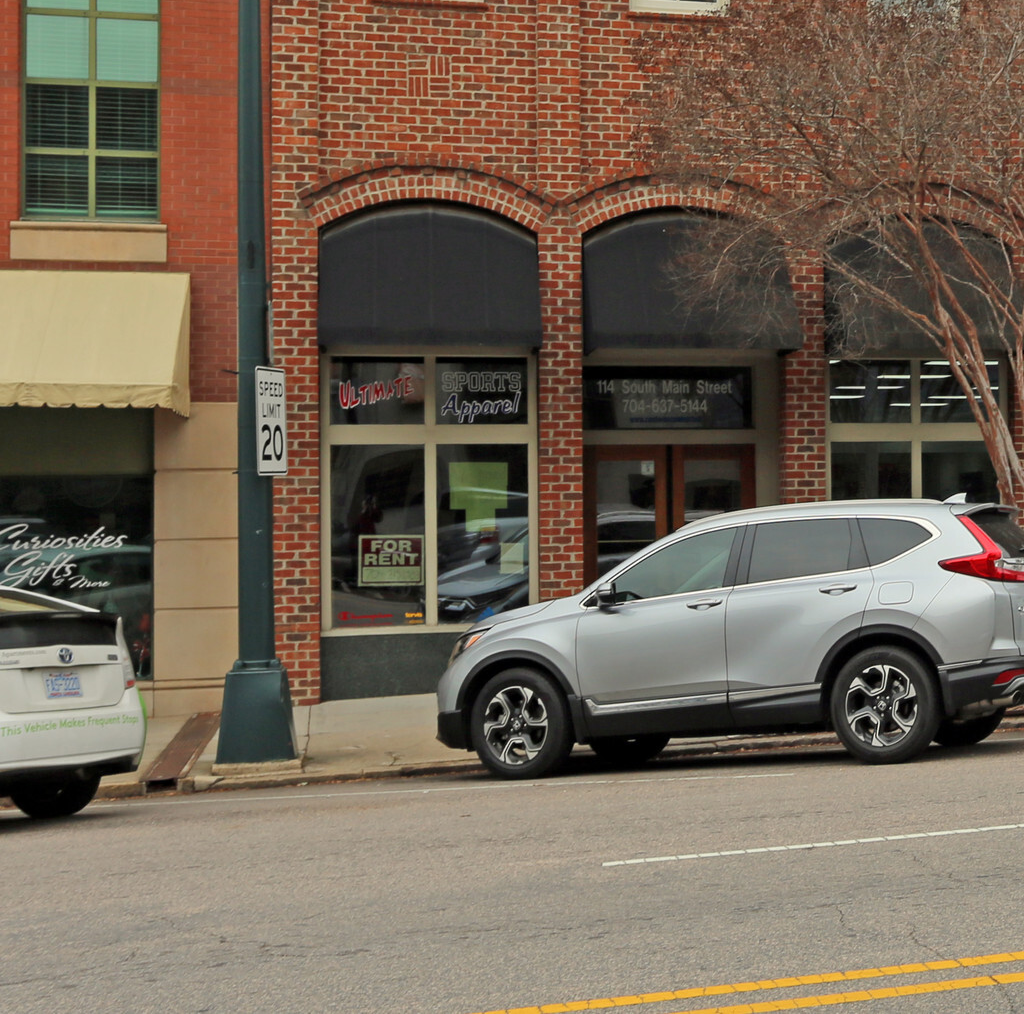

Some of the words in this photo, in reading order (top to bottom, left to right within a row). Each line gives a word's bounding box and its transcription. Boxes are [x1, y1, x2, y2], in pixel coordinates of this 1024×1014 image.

[259, 380, 283, 398] SPEED
[442, 372, 521, 392] SPORTS
[597, 379, 615, 394] 114
[622, 379, 656, 395] South
[662, 379, 690, 394] Main
[697, 379, 732, 395] Street
[339, 376, 415, 410] ULTIMATE
[262, 403, 281, 419] LIMIT
[441, 391, 522, 423] Apparel
[622, 398, 708, 413] 704-637-5144
[261, 424, 284, 461] 20
[0, 523, 128, 551] Curiosities
[370, 540, 412, 553] FOR
[2, 550, 77, 587] Gifts
[364, 553, 419, 565] RENT
[68, 574, 111, 588] More
[1, 726, 22, 737] This
[24, 722, 57, 733] Vehicle
[59, 718, 86, 728] Makes
[88, 716, 120, 727] Frequent
